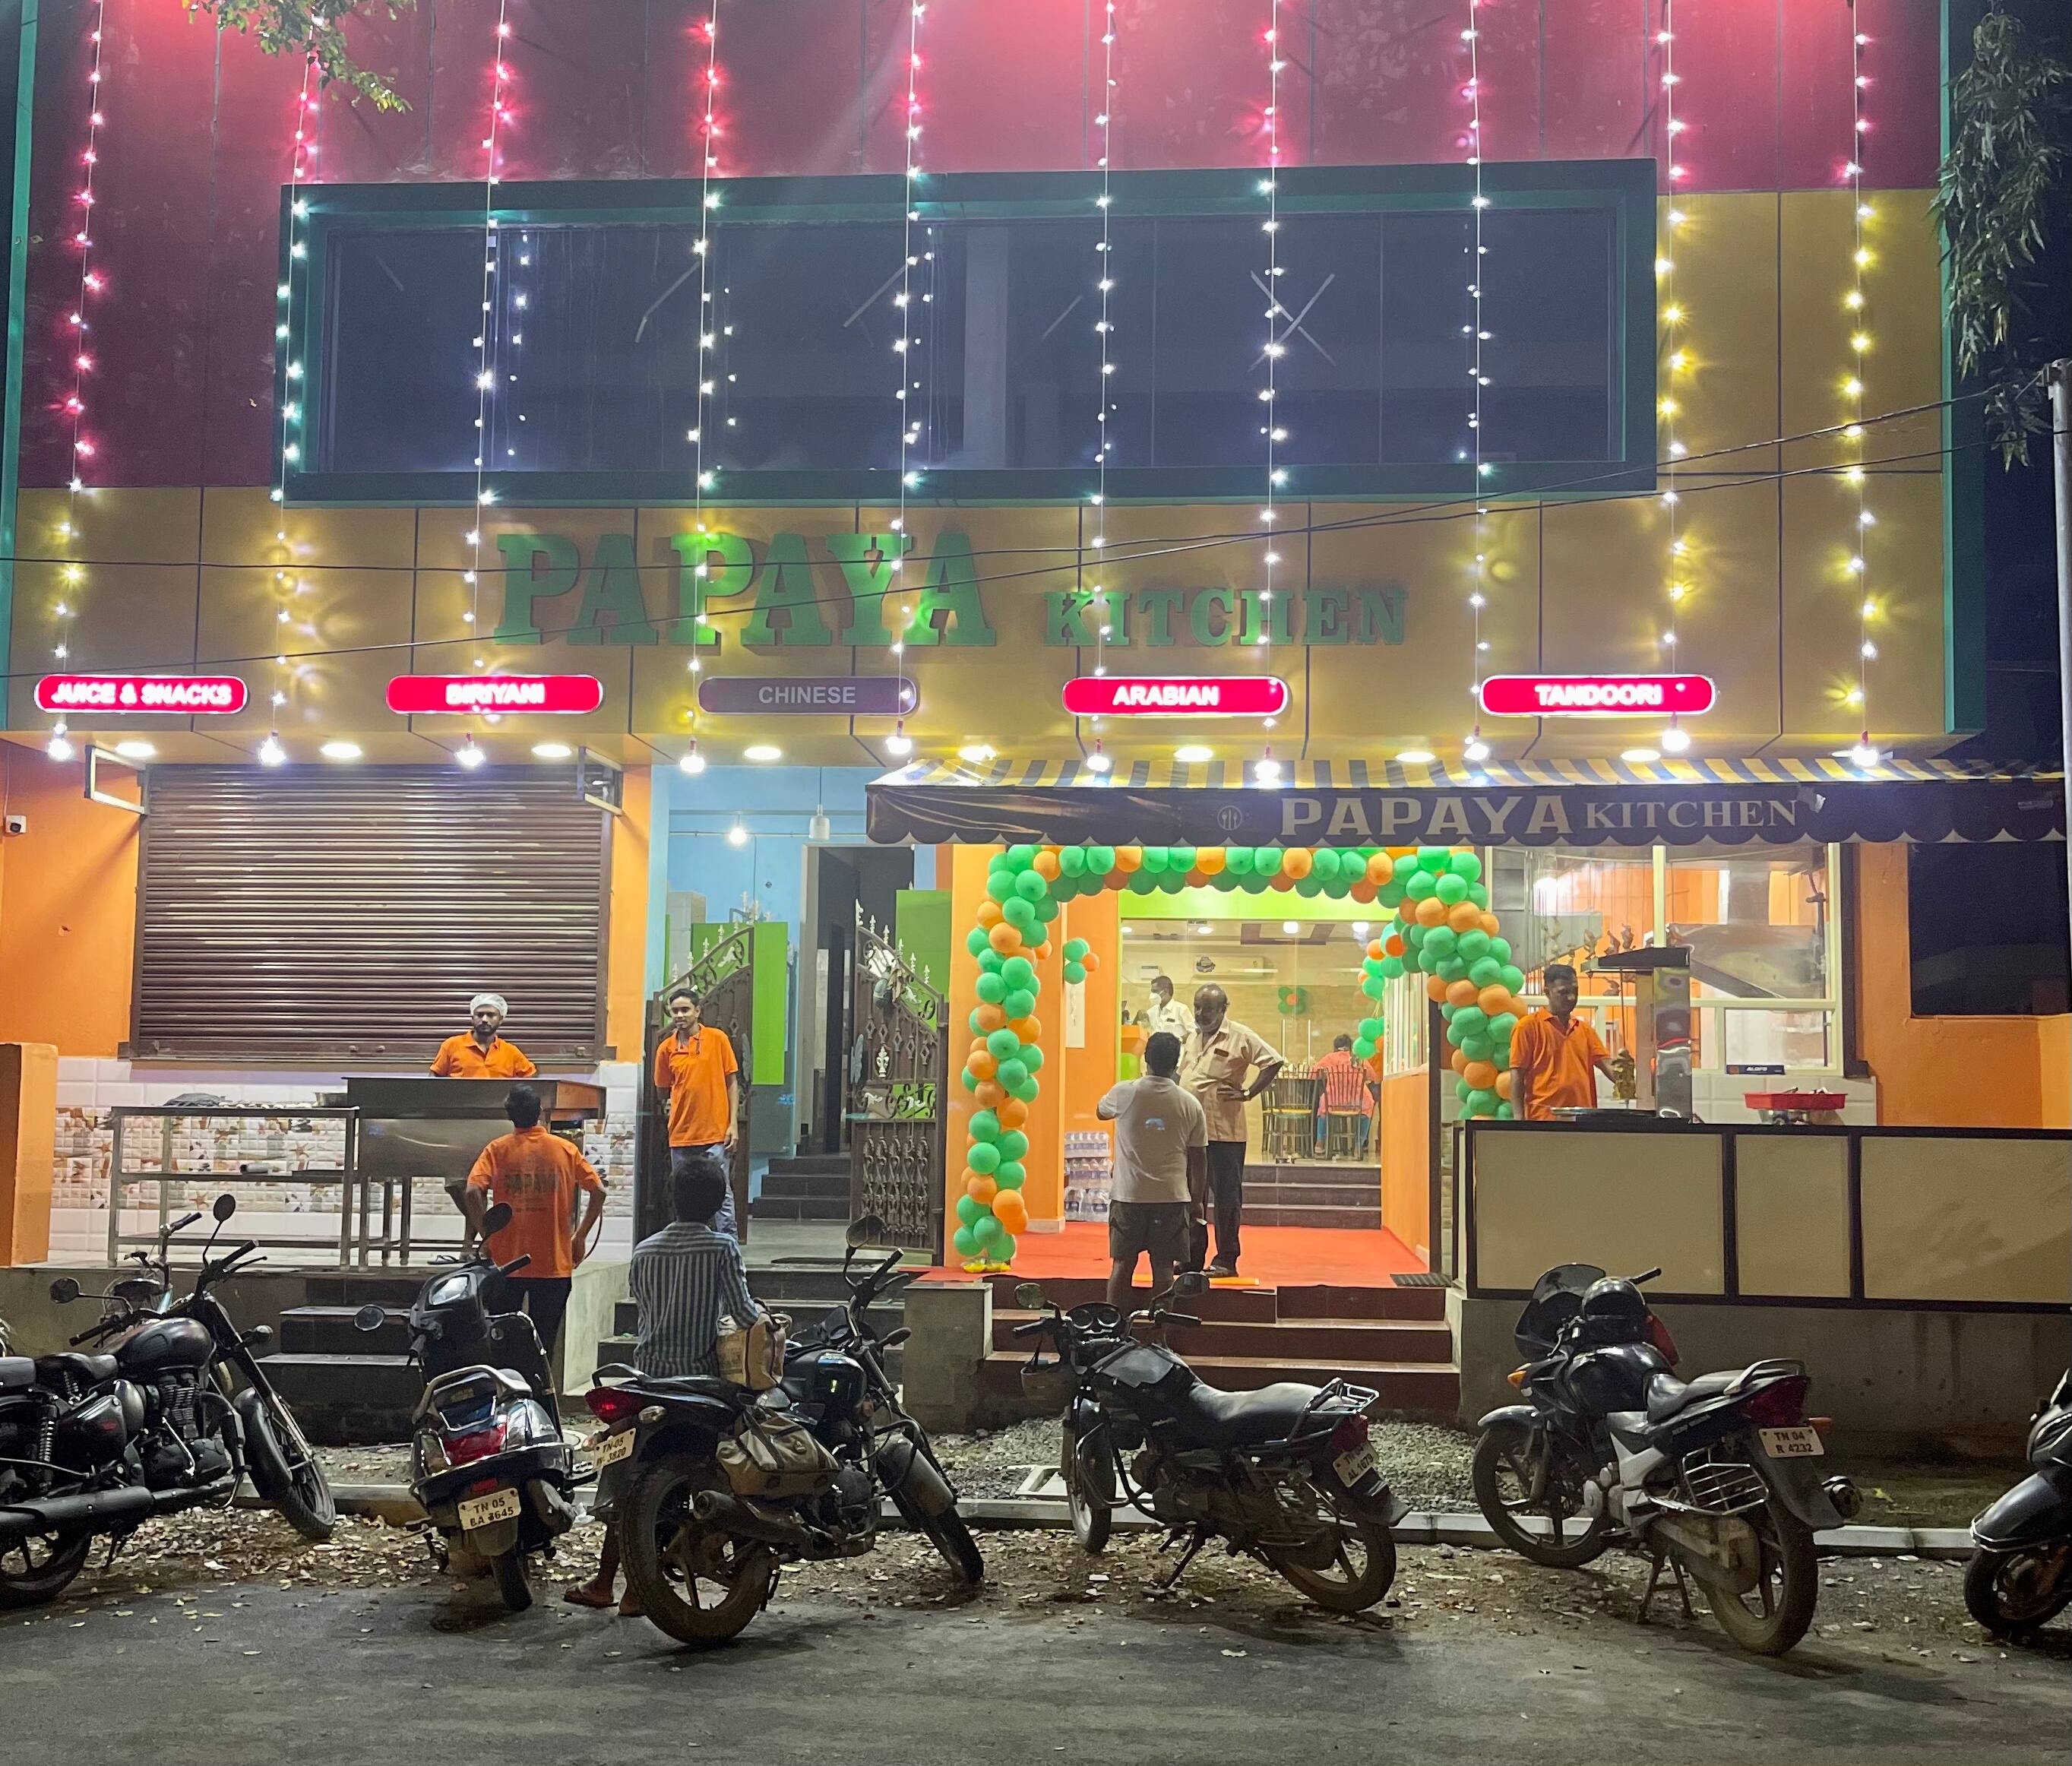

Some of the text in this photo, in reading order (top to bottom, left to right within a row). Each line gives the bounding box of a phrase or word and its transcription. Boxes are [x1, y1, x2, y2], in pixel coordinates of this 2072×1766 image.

[494, 533, 1409, 647] PAPAYA KITCHEN
[51, 682, 233, 705] JUICE & SNACKS
[445, 683, 546, 705] BIRIYANI
[758, 686, 856, 704] CHINESE
[1112, 685, 1219, 706] ARABIAN
[1534, 684, 1664, 706] TANDOORI
[1281, 795, 1798, 836] PAPAYA KITCHEN
[1789, 1443, 1814, 1453] 4232
[473, 1496, 505, 1514] TN 05
